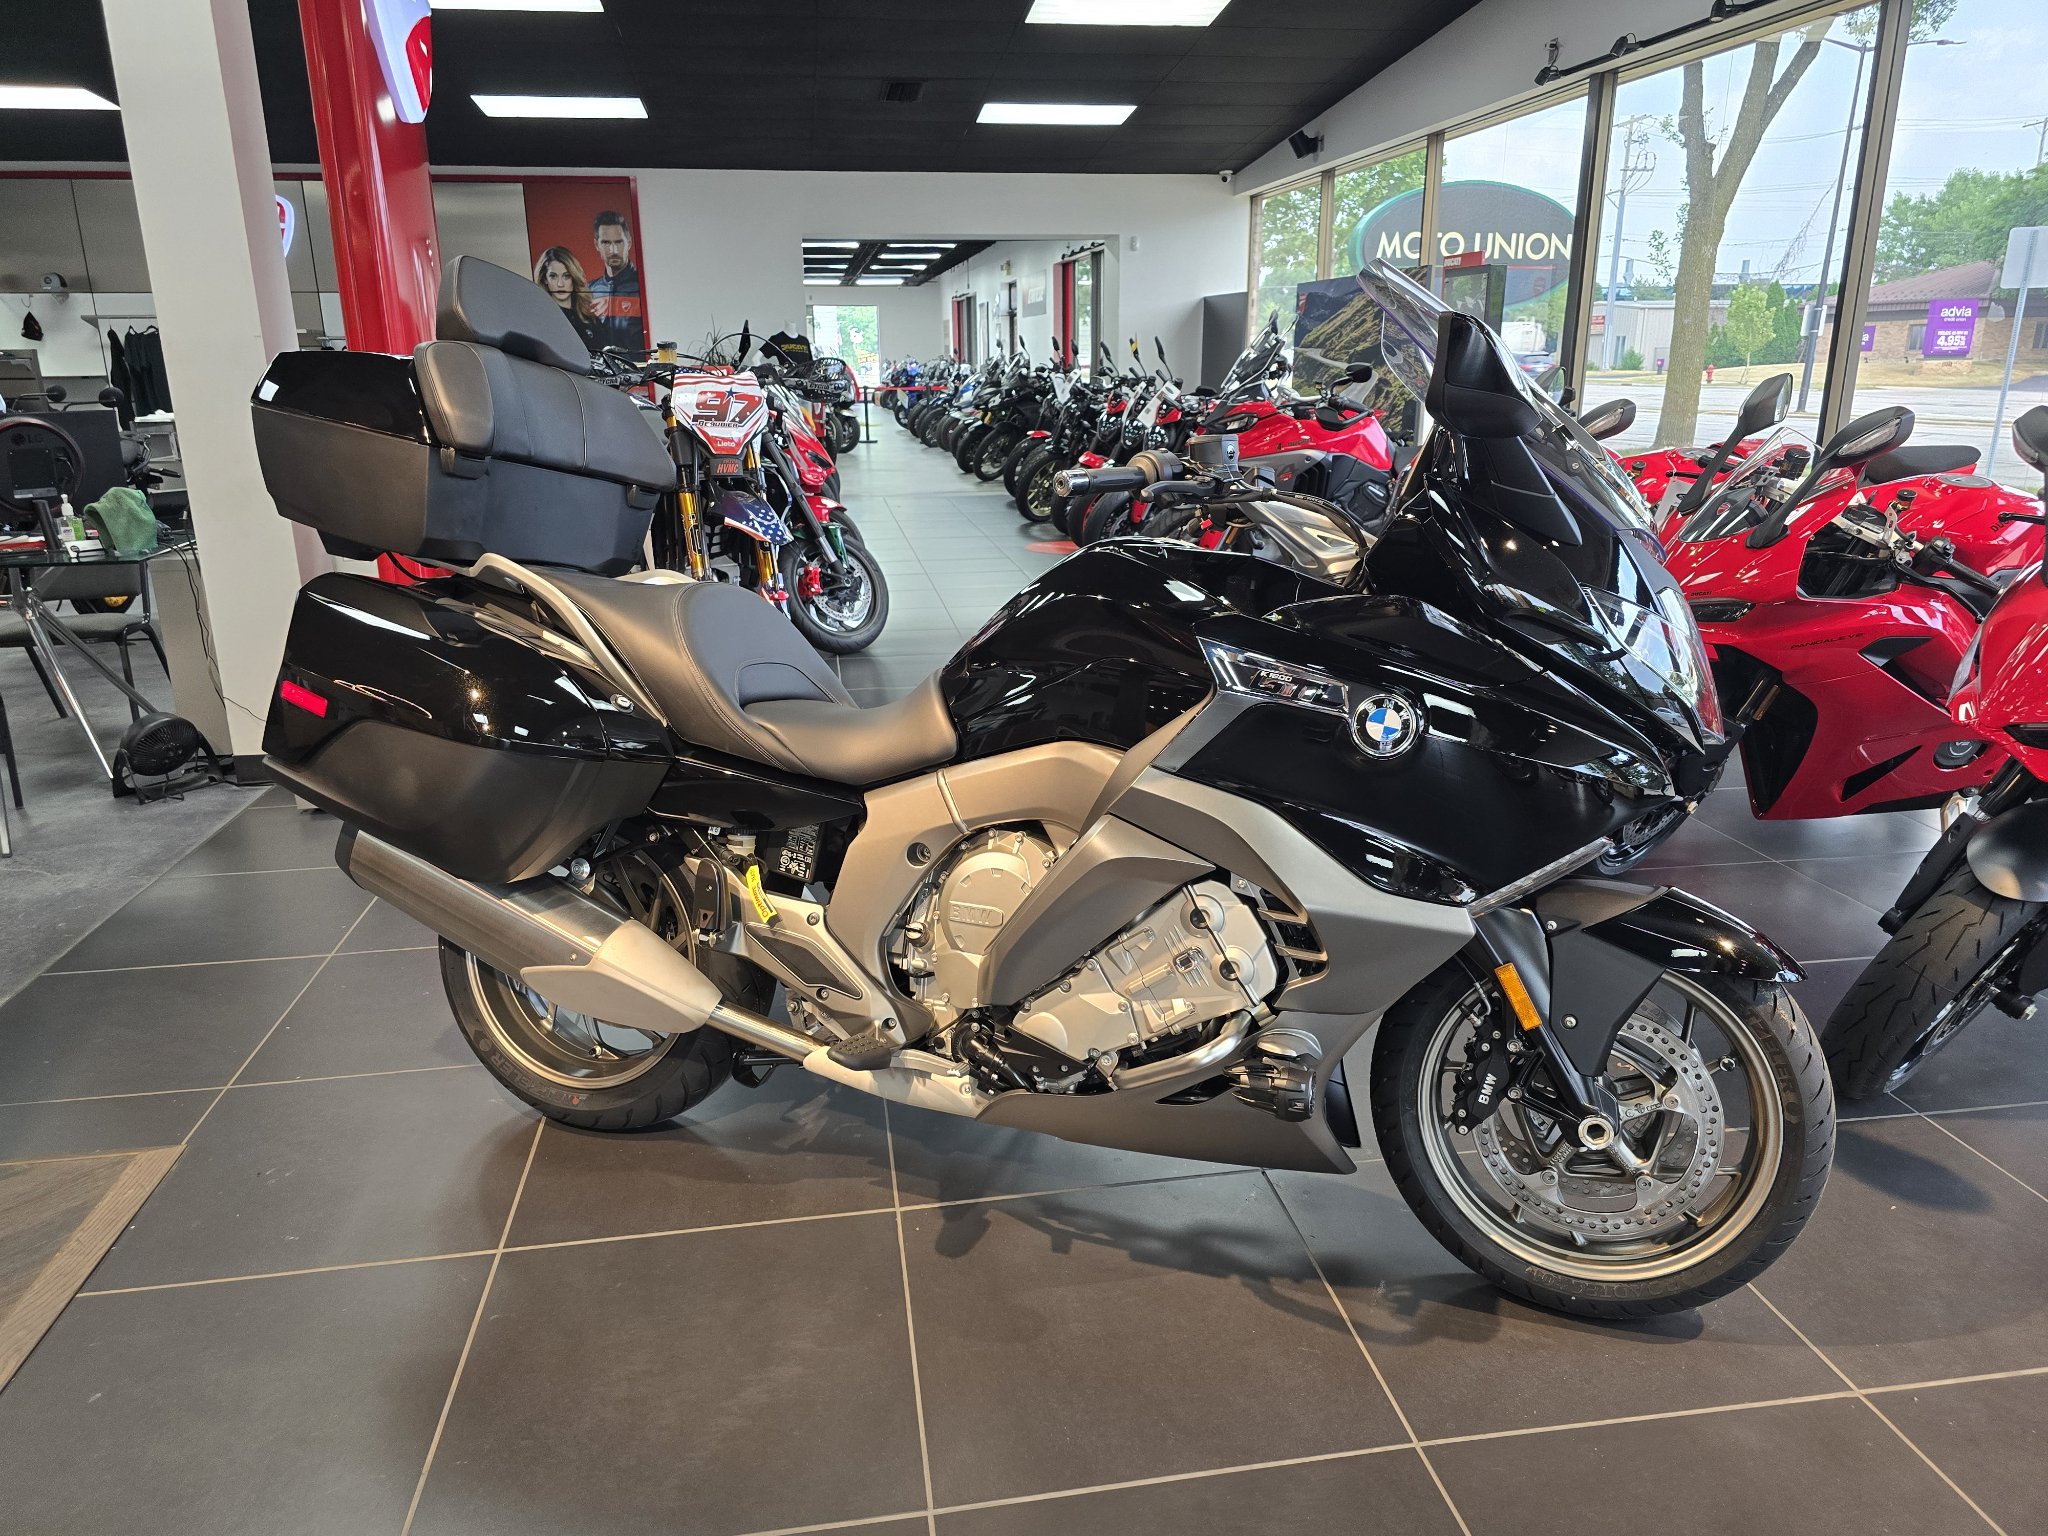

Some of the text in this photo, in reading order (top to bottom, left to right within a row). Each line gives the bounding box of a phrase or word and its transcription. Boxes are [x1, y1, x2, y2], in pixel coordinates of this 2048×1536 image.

[1376, 231, 1573, 260] MOO UNION
[1940, 306, 1972, 317] advia
[691, 390, 764, 424] 97
[1790, 632, 1865, 650] PANIGALE V2
[1365, 699, 1410, 720] BMW
[951, 904, 992, 924] BMW
[1478, 1073, 1497, 1105] BMW
